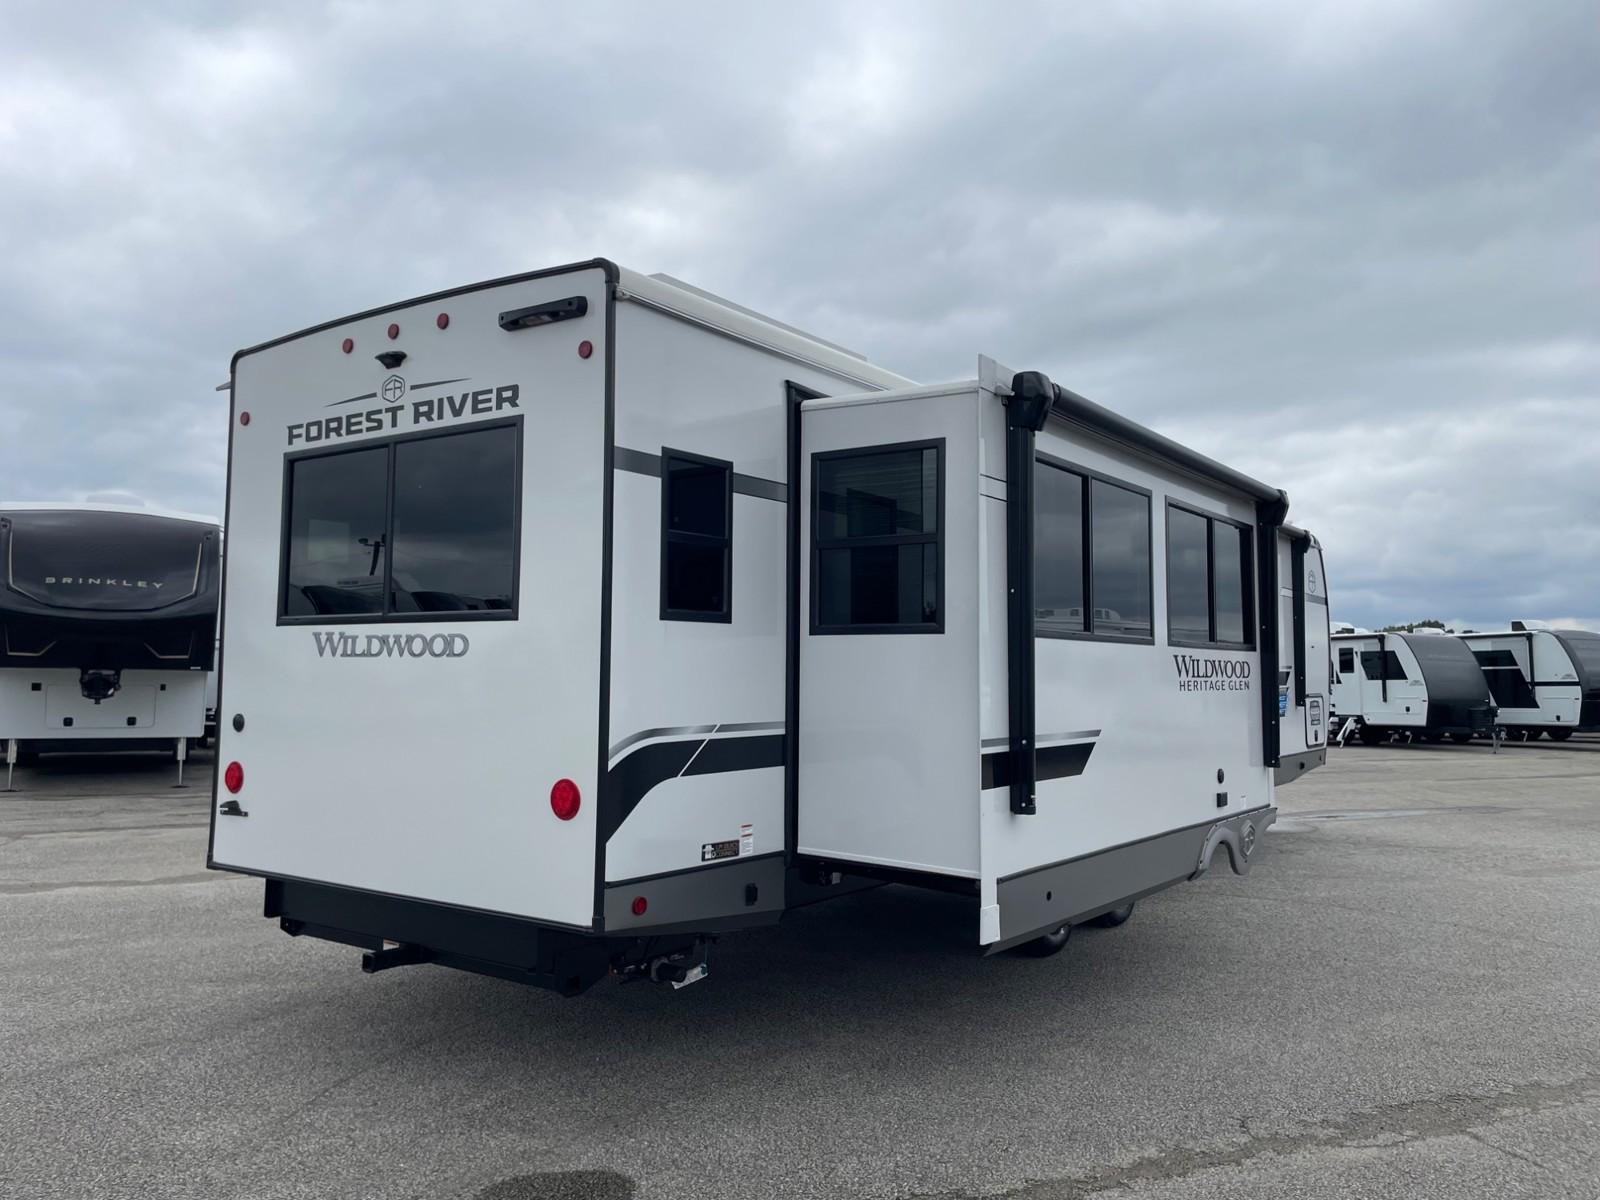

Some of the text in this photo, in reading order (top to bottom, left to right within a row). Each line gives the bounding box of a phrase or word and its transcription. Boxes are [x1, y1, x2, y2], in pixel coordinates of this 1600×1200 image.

[287, 384, 520, 446] FOREST RIVER
[45, 577, 163, 589] BRINKLEY
[312, 631, 470, 658] WILDWOOD
[1173, 654, 1250, 679] WILDWOOD
[1179, 680, 1250, 692] HERITAGE GLEN
